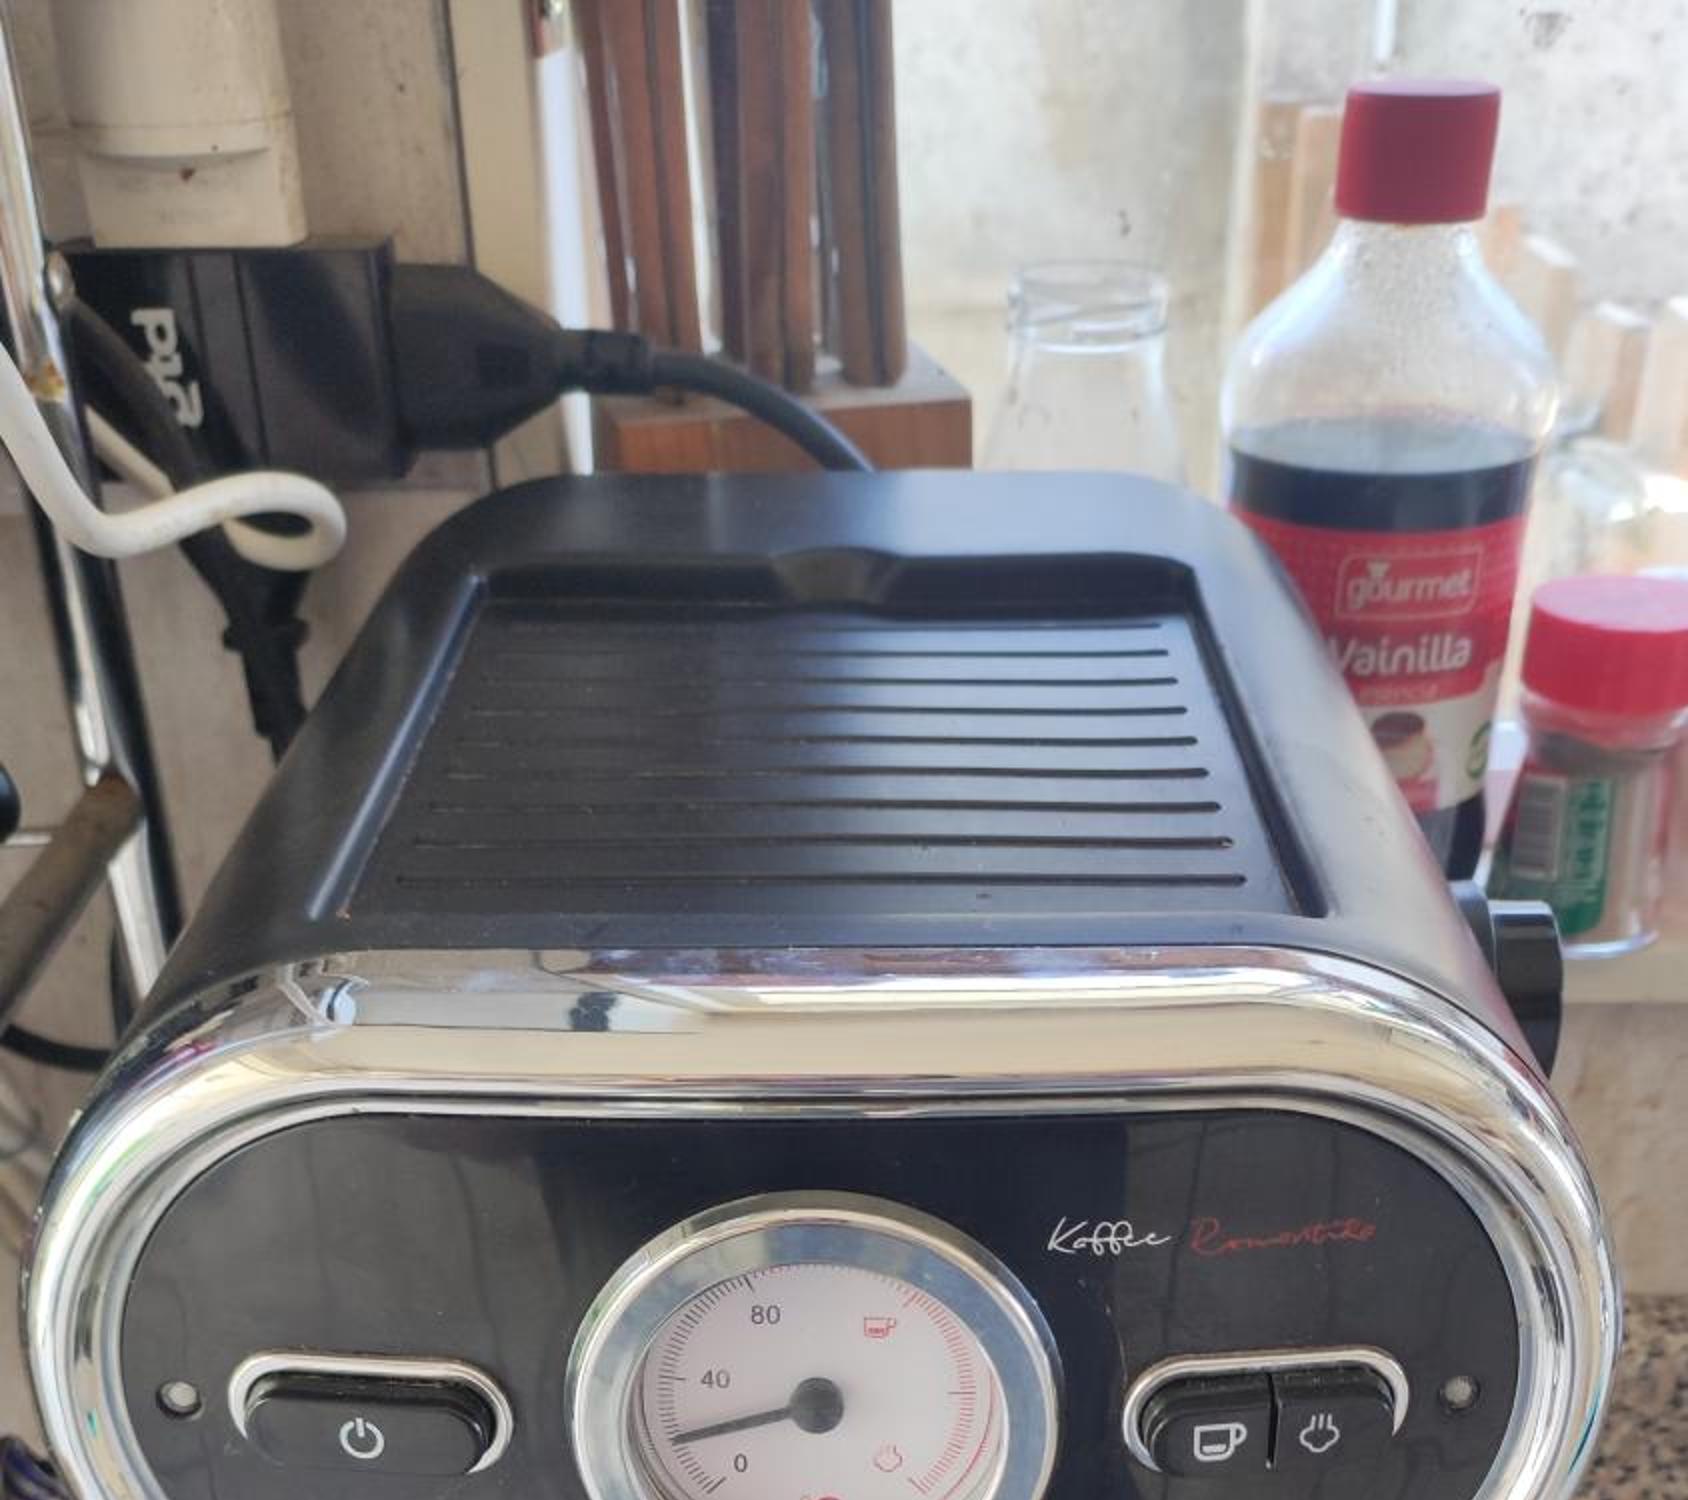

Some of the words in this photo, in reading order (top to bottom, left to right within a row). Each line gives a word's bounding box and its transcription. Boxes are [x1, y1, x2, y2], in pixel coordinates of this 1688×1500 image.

[1347, 567, 1473, 610] gourmet
[1328, 633, 1473, 677] Vainilla
[750, 1305, 781, 1325] 80
[700, 1369, 730, 1389] 40
[733, 1453, 748, 1473] 0
